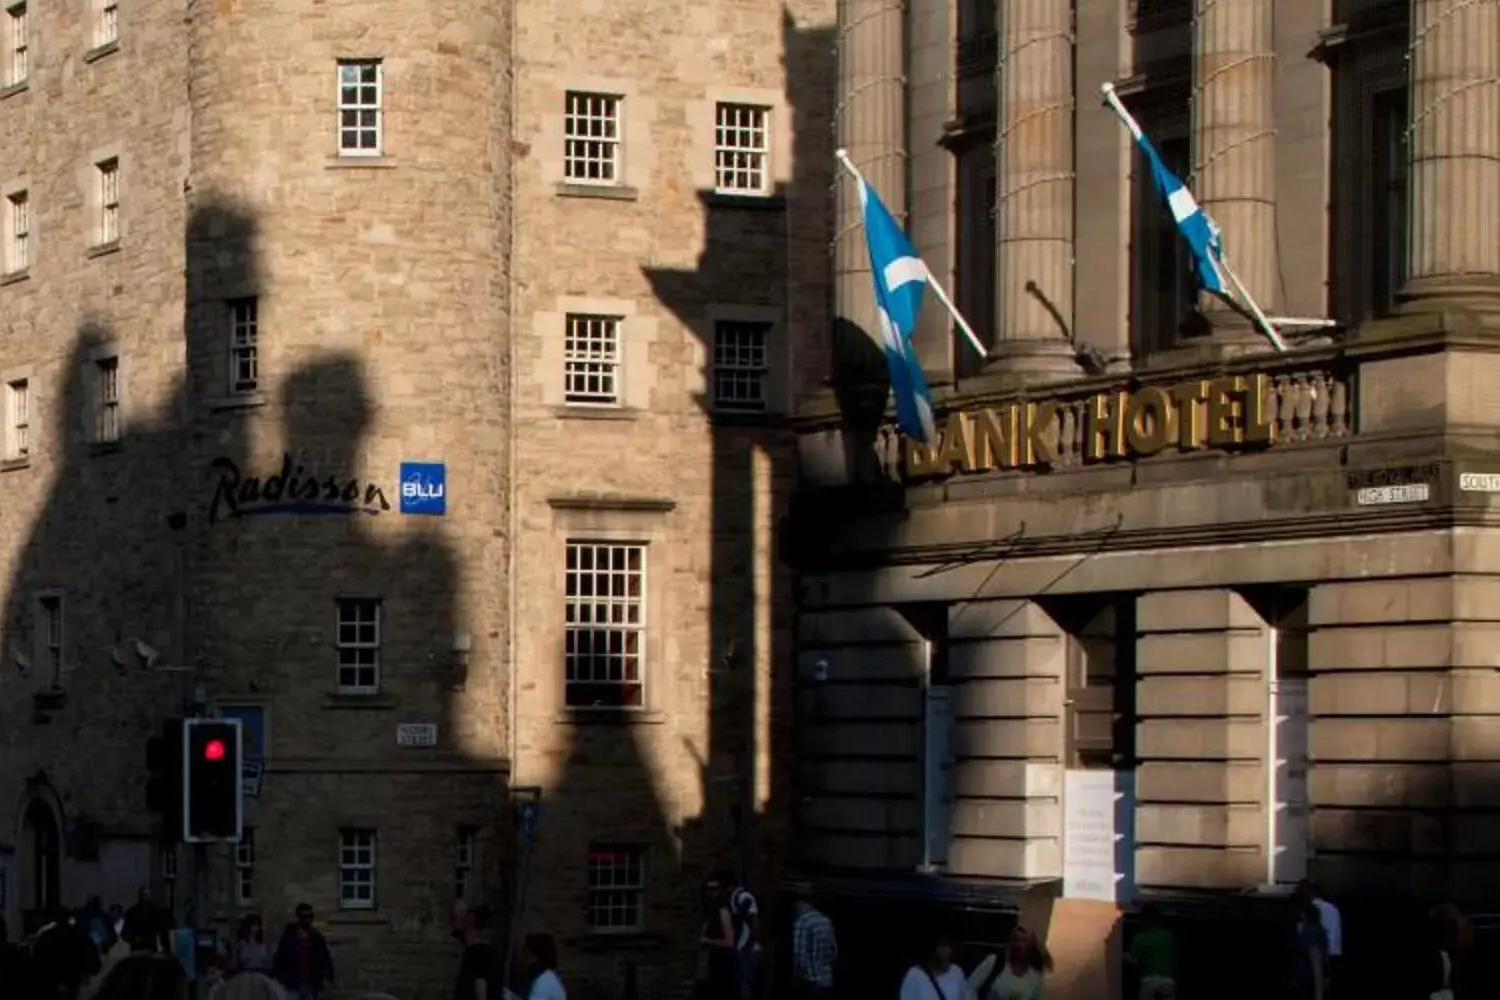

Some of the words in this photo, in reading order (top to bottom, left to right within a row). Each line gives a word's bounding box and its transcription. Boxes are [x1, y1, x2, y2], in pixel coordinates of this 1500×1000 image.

[1083, 374, 1278, 460] HOTEL
[210, 453, 390, 523] Radisson
[403, 482, 443, 497] BLU
